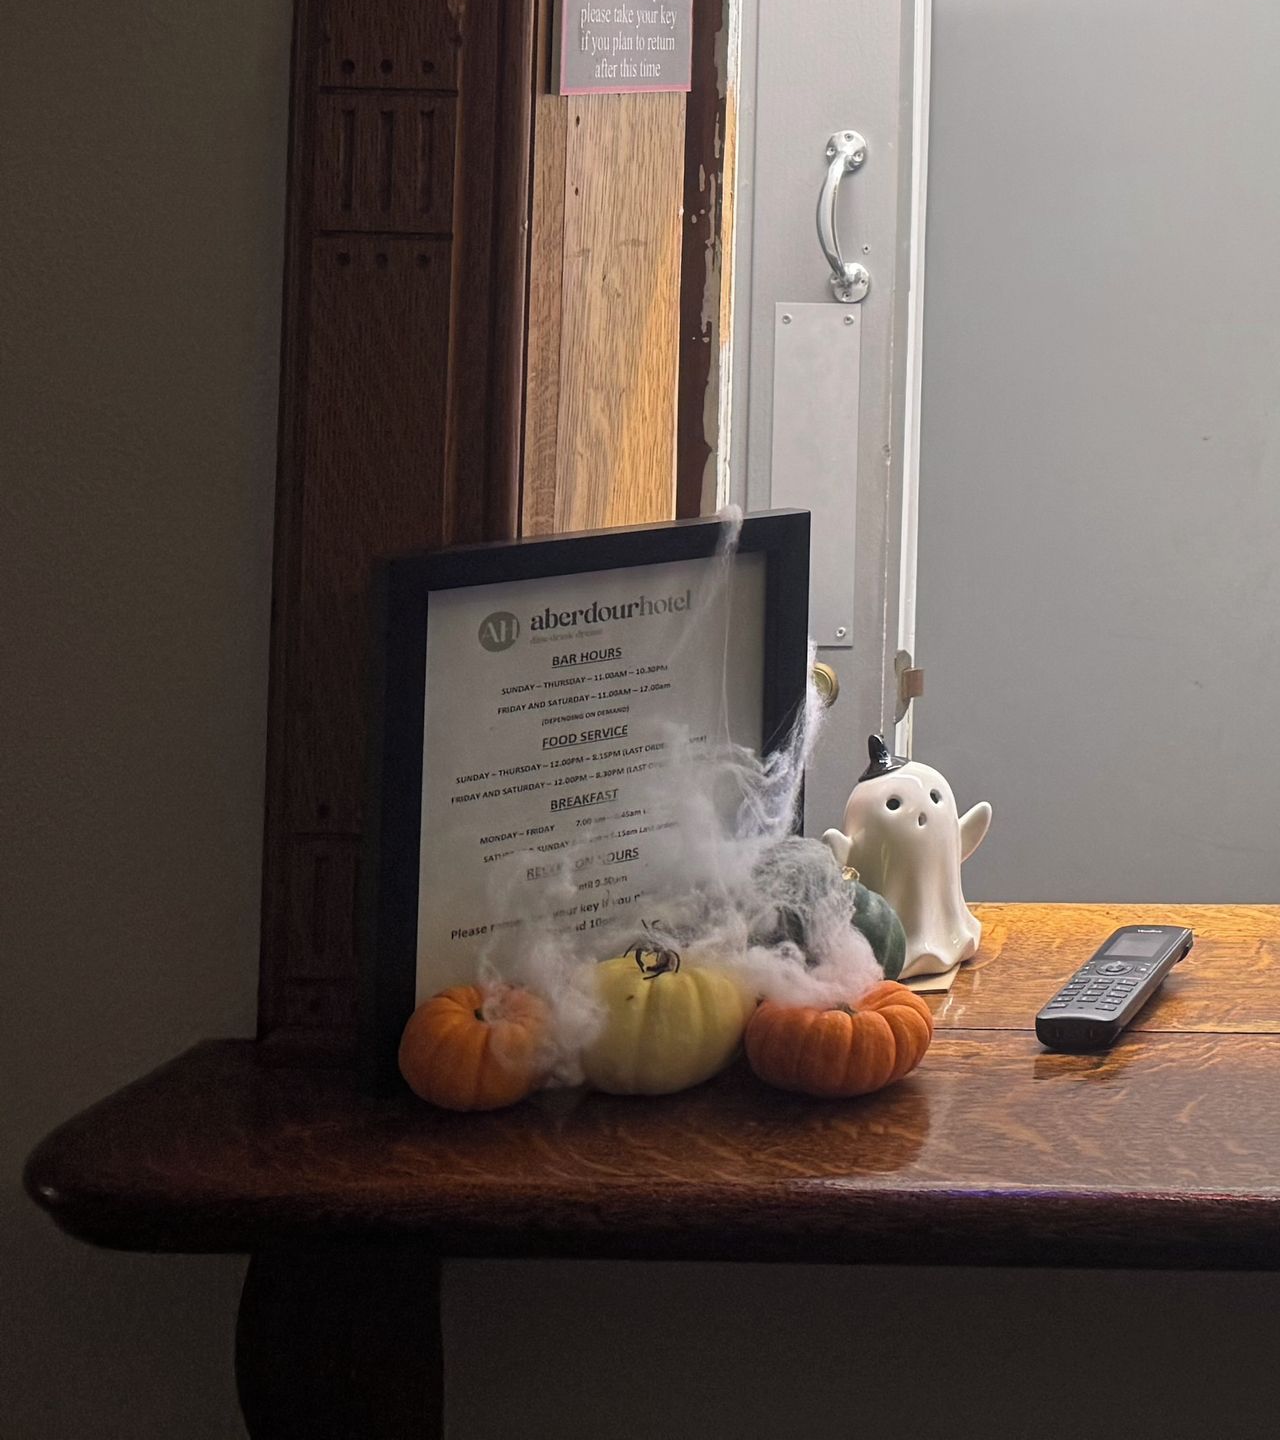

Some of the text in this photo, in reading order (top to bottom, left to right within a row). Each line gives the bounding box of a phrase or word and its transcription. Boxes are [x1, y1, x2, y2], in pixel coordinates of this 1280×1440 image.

[580, 2, 677, 30] please take your key
[581, 30, 675, 56] if you plan to return
[595, 58, 661, 79] after this time
[530, 589, 692, 631] aberdourhotel
[552, 647, 622, 667] BAR HOURS
[501, 684, 535, 696] SUNDAY
[543, 676, 586, 689] THURSDAY
[497, 704, 526, 715] FRIDAY
[528, 701, 546, 710] AND
[547, 694, 590, 708] SATURDAY
[585, 711, 596, 720] ON
[542, 725, 629, 749] FOOD SERVICE
[456, 772, 490, 784] SUNDAY
[498, 764, 542, 777] THURSDAY
[622, 745, 644, 758] (LAST
[451, 793, 481, 804] FRIDAY
[482, 789, 500, 799] AND
[502, 782, 546, 795] SATURDAY
[550, 789, 619, 810] BREAKFAST
[480, 831, 519, 844] MONDAY
[526, 825, 555, 836] FRIDAY
[537, 840, 569, 853] SUNDAY
[580, 900, 600, 914] key
[450, 925, 488, 941] Please
